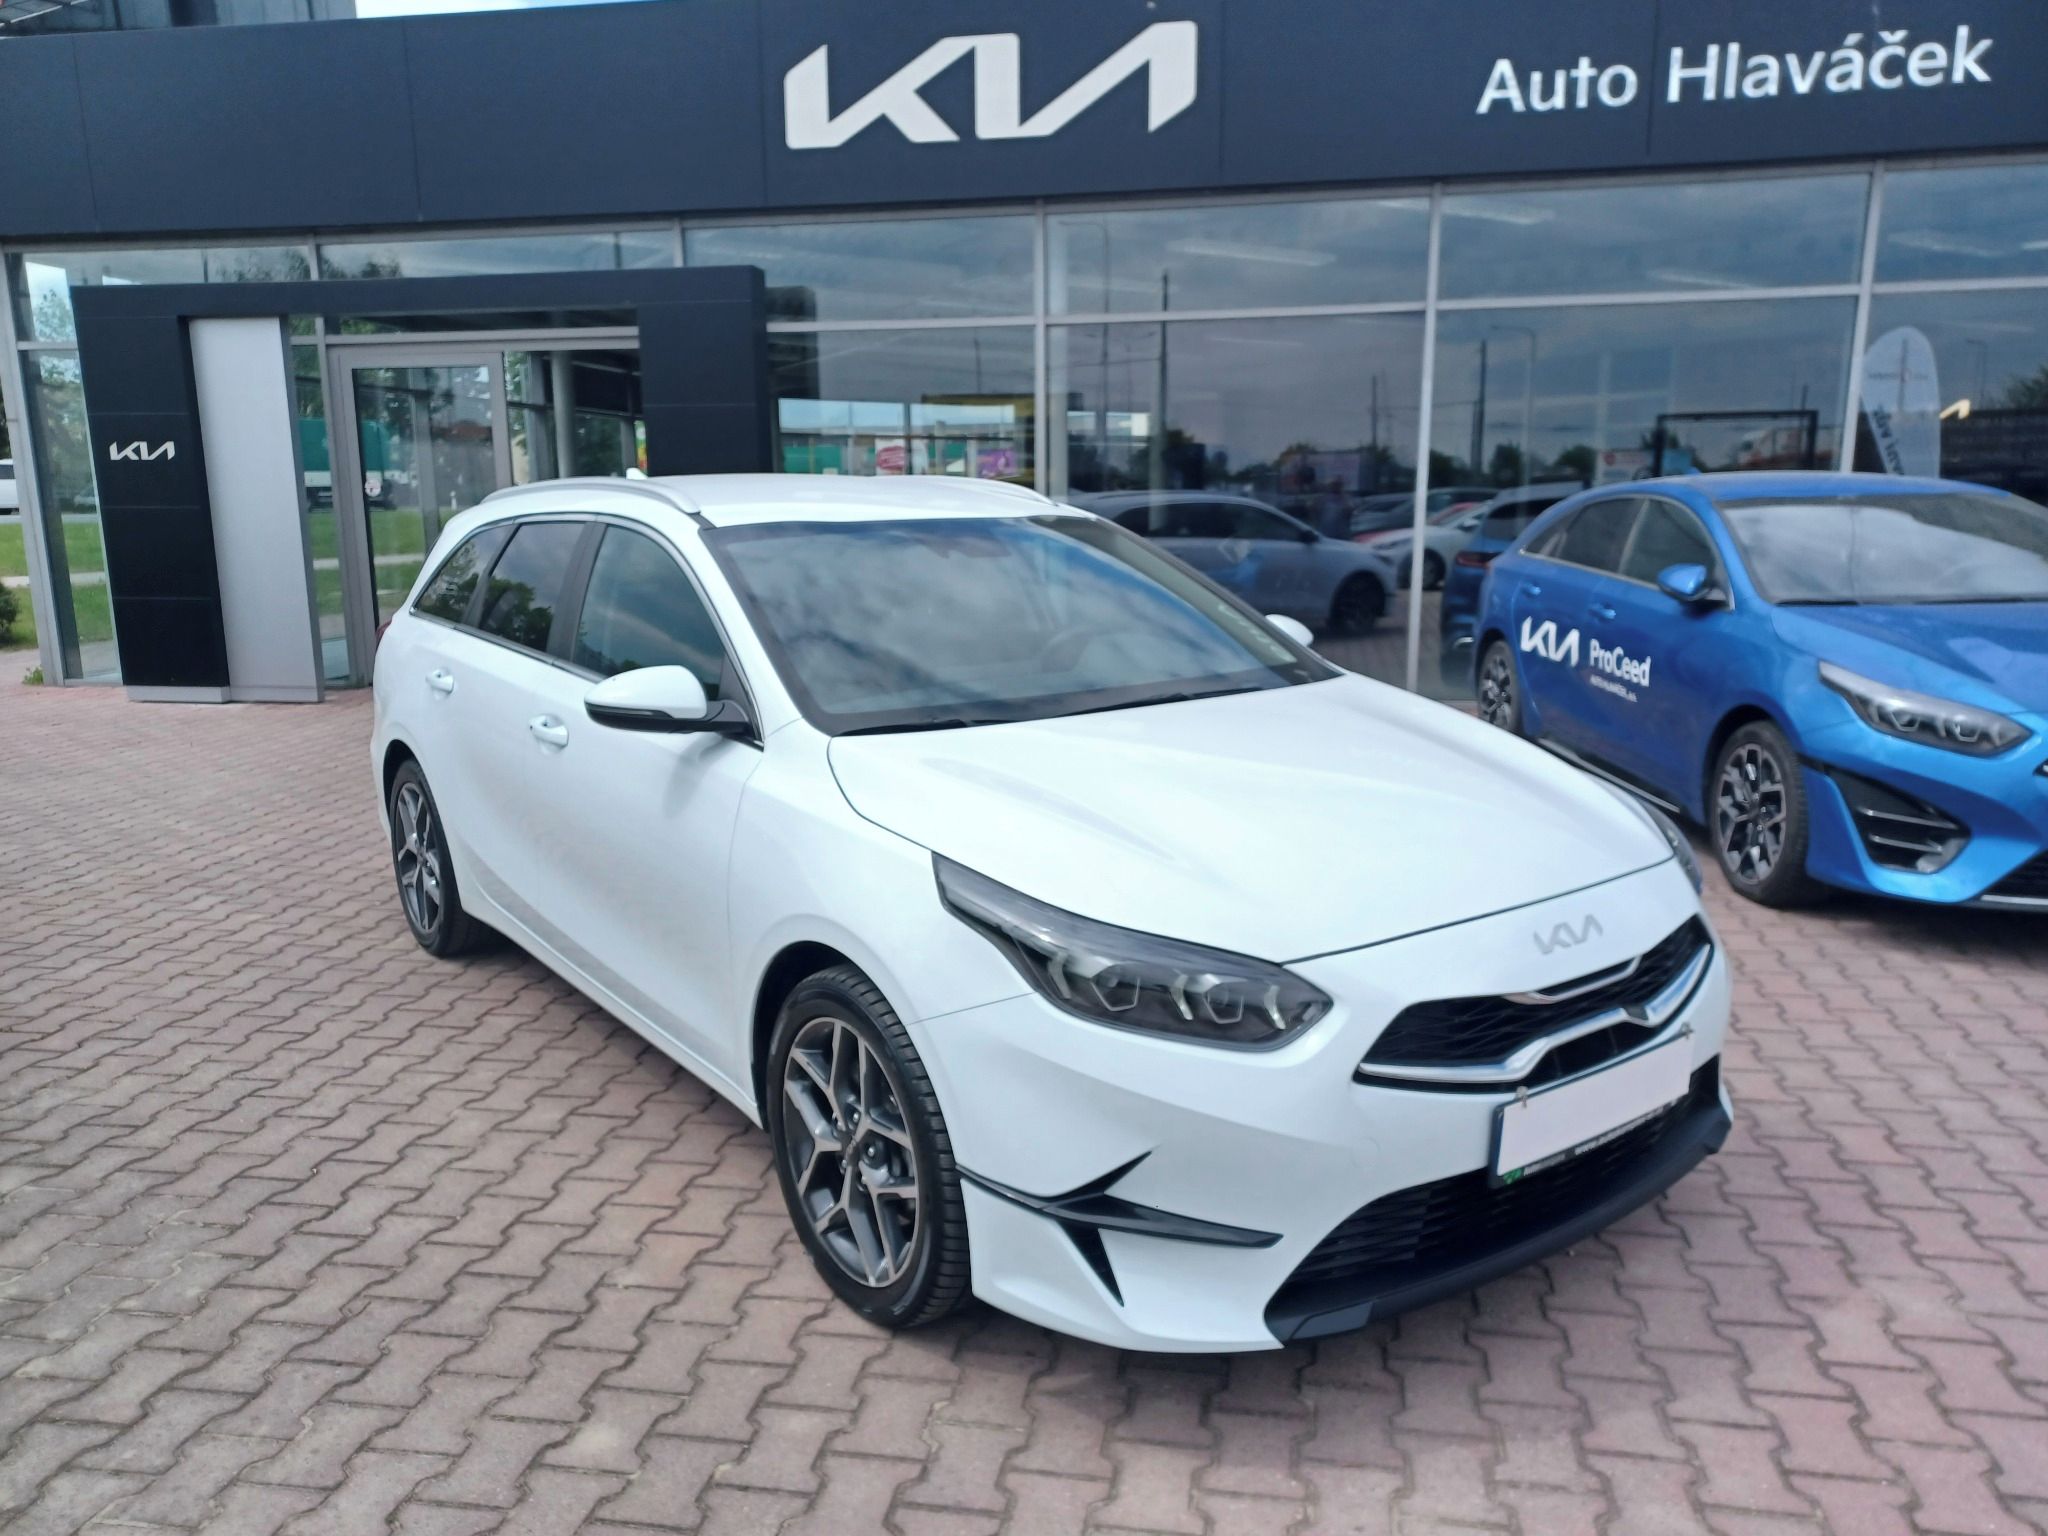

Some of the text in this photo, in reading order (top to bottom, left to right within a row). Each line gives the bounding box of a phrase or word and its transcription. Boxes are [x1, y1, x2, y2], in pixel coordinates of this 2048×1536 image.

[783, 20, 1199, 150] KIA
[1475, 24, 1995, 115] Auto Hlaváček
[108, 440, 176, 461] KIA
[1520, 615, 1652, 688] KIA ProCeed
[1532, 913, 1604, 956] KIA
